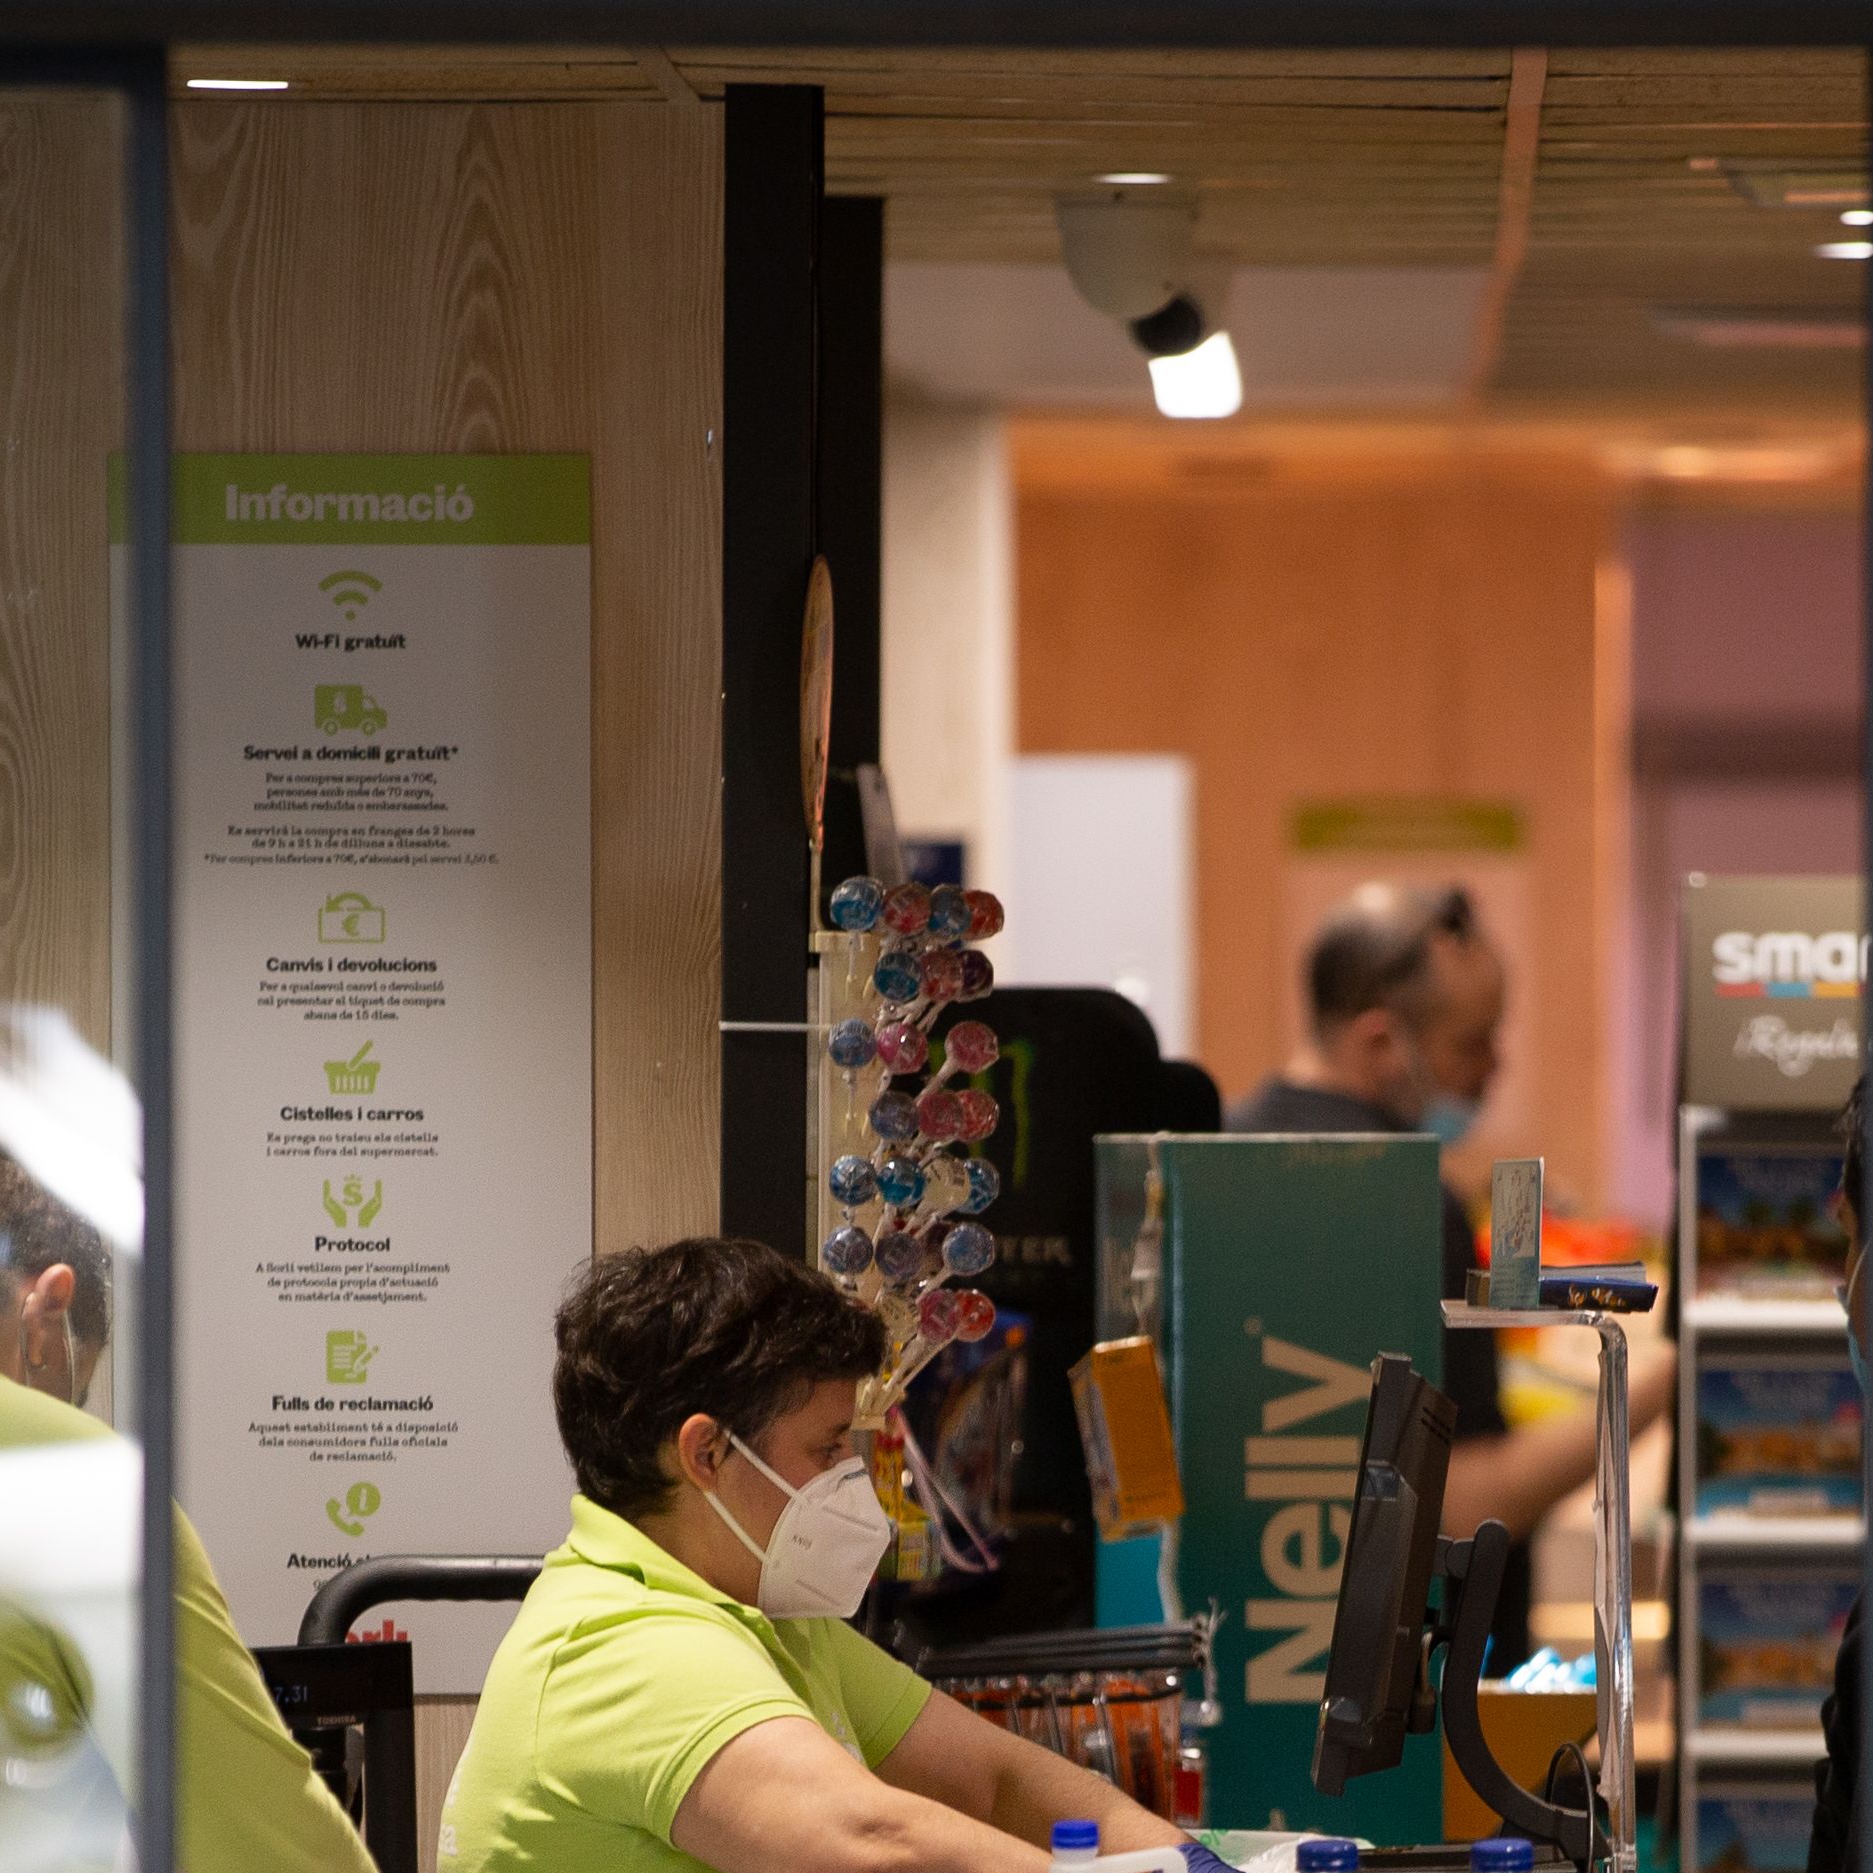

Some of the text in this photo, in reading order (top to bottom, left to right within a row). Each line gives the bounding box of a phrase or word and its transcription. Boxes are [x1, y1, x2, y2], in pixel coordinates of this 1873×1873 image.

[226, 484, 474, 521] Informació
[295, 633, 407, 651] Wi-Fi gratuït
[244, 746, 298, 760] Servei
[303, 749, 312, 760] a
[316, 746, 381, 760] domicili
[266, 958, 437, 972] Canvis i devolucions
[280, 1106, 424, 1121] Cistelles i carros
[315, 1236, 391, 1251] Protocol
[272, 1395, 434, 1411] Fulls de reclamació
[1245, 1335, 1375, 1704] Nelly
[286, 1553, 353, 1568] Atenció
[317, 1715, 356, 1726] TOSHIBA
